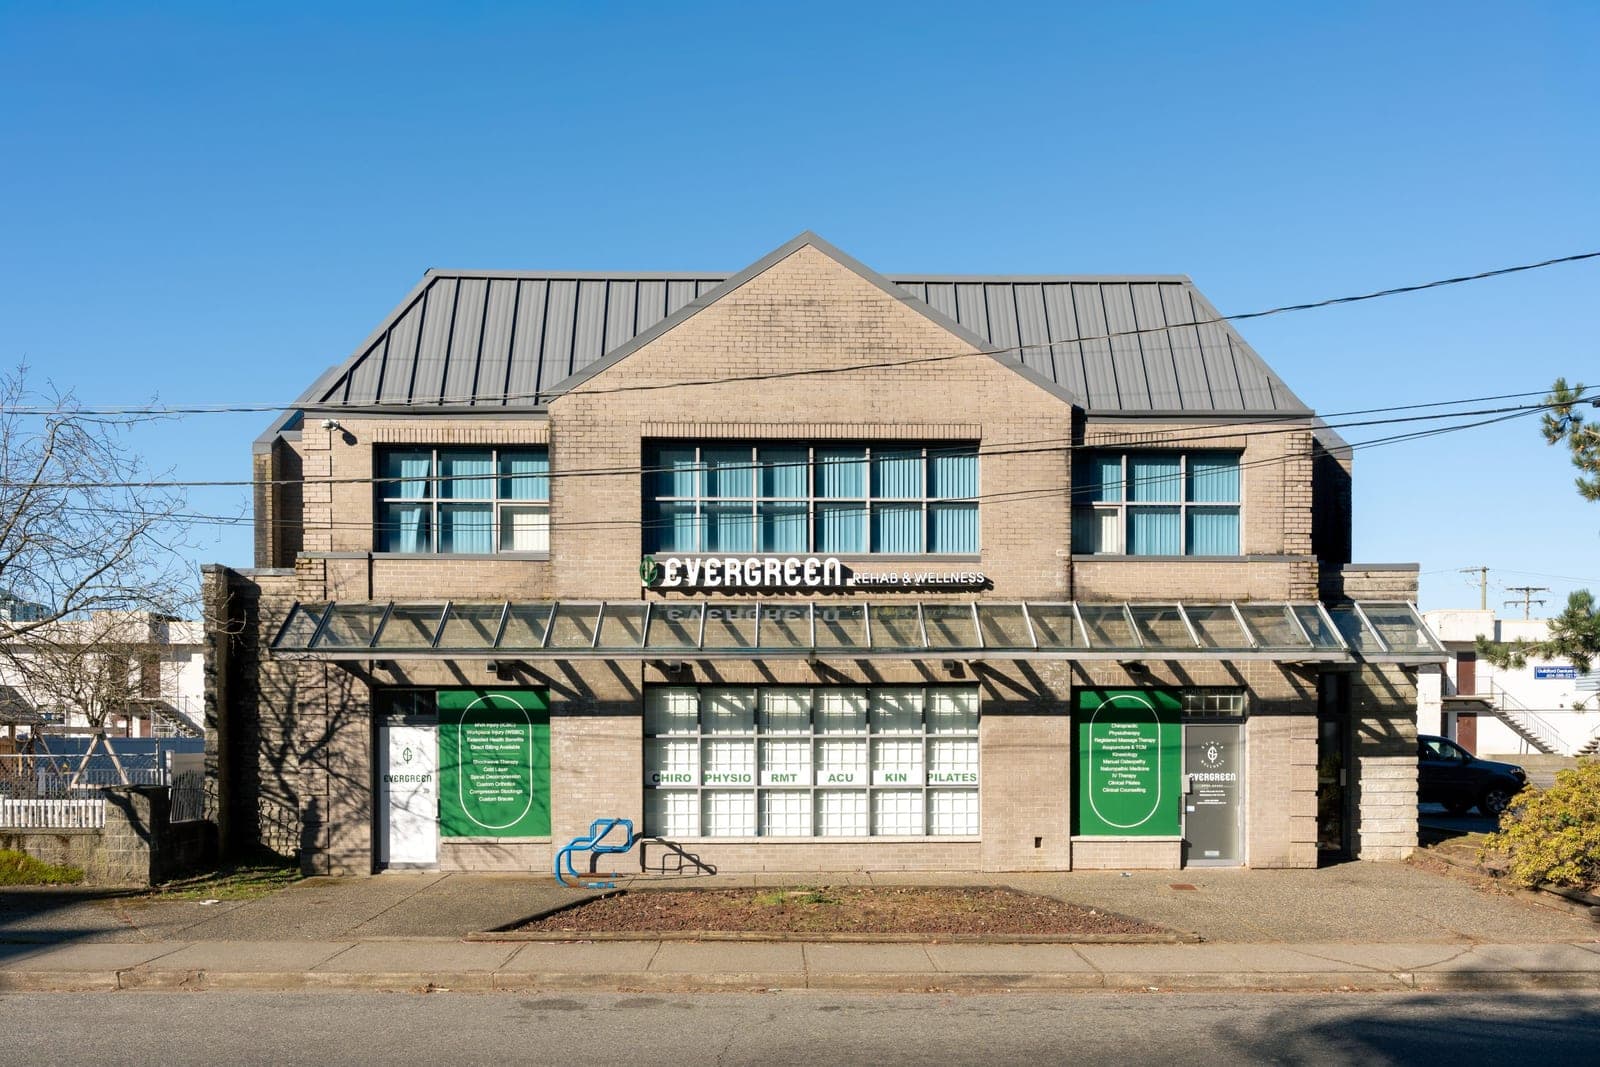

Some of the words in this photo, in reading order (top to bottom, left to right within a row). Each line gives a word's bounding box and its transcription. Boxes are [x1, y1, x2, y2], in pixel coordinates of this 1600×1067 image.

[664, 557, 841, 587] EVERGREEN
[853, 572, 898, 584] REHAB
[902, 572, 911, 583] &
[914, 571, 985, 584] WELLNESS
[652, 773, 692, 783] CHIRO
[704, 773, 752, 783] PHYSIO
[771, 773, 798, 783] RMT
[828, 773, 854, 783] ACU
[885, 773, 908, 783] KIN
[927, 773, 977, 783] PILATES
